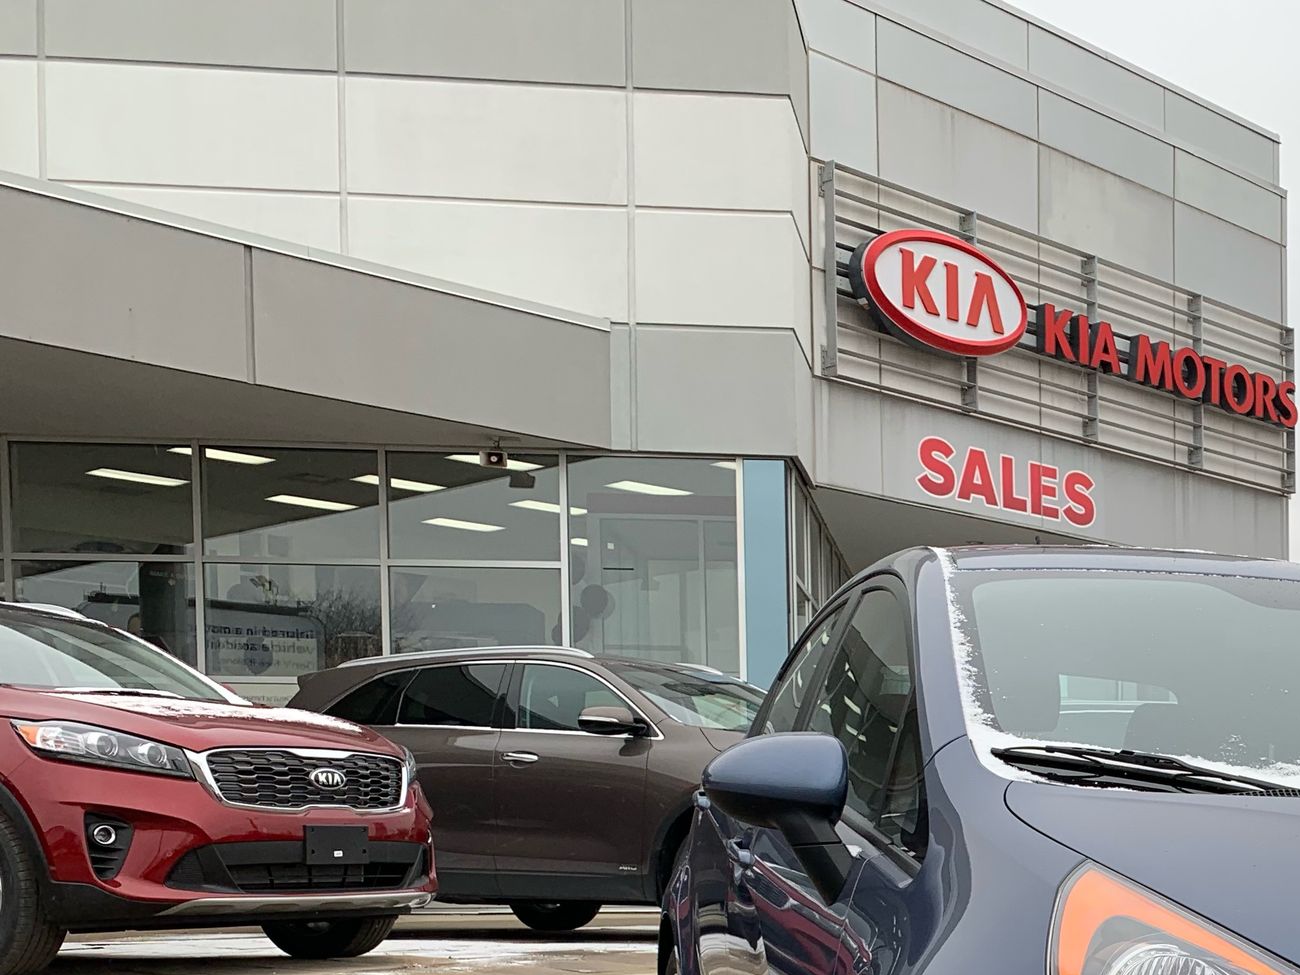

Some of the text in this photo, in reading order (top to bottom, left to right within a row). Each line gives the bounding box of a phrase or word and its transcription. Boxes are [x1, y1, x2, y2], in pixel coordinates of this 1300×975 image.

[899, 247, 1004, 335] KIA
[1041, 303, 1298, 428] KIA MOTORS
[916, 435, 1097, 528] SALES
[317, 772, 342, 786] KIA
